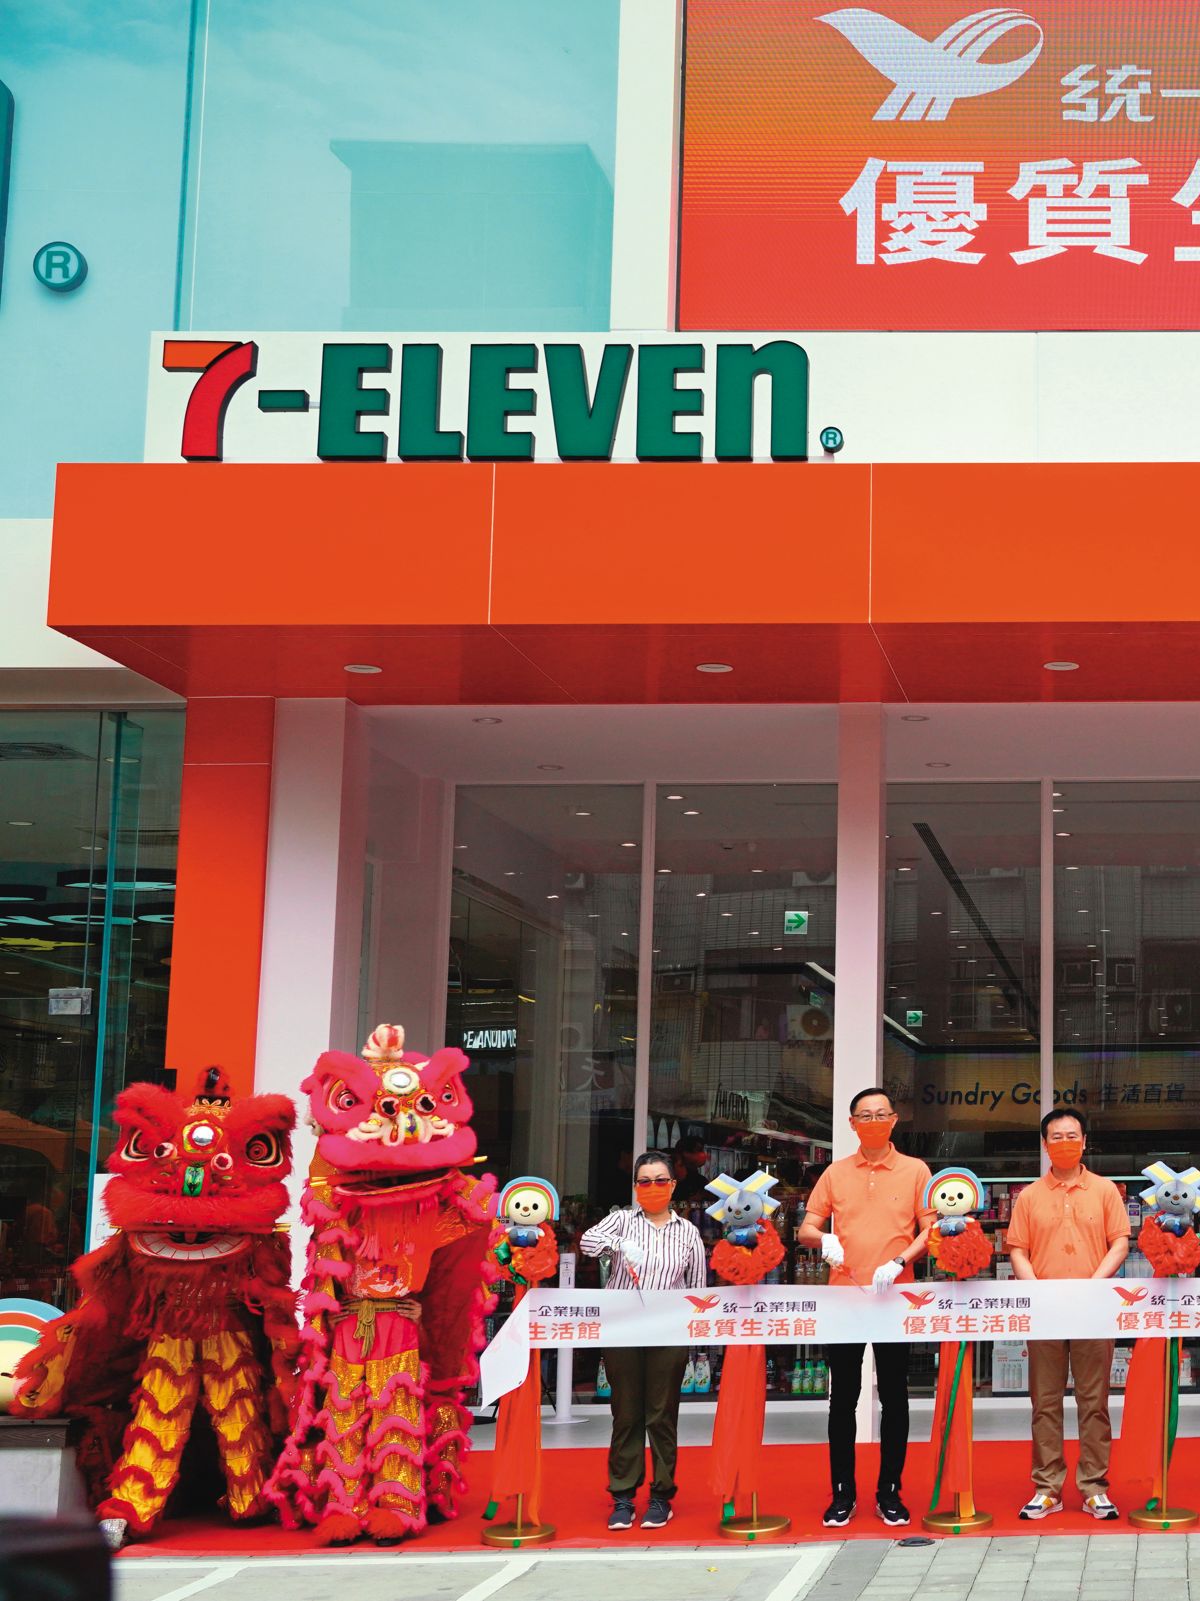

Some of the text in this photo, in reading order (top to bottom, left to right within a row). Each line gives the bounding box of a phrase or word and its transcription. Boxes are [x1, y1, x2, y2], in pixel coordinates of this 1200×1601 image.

[922, 1083, 1005, 1111] Sundry
[1101, 1082, 1186, 1104] 生活百貨
[723, 1300, 817, 1313] 統一企業集團
[938, 1297, 1031, 1310] 統一企業集團
[687, 1317, 818, 1338] 優質生活館
[902, 1314, 1032, 1335] 優質生活館
